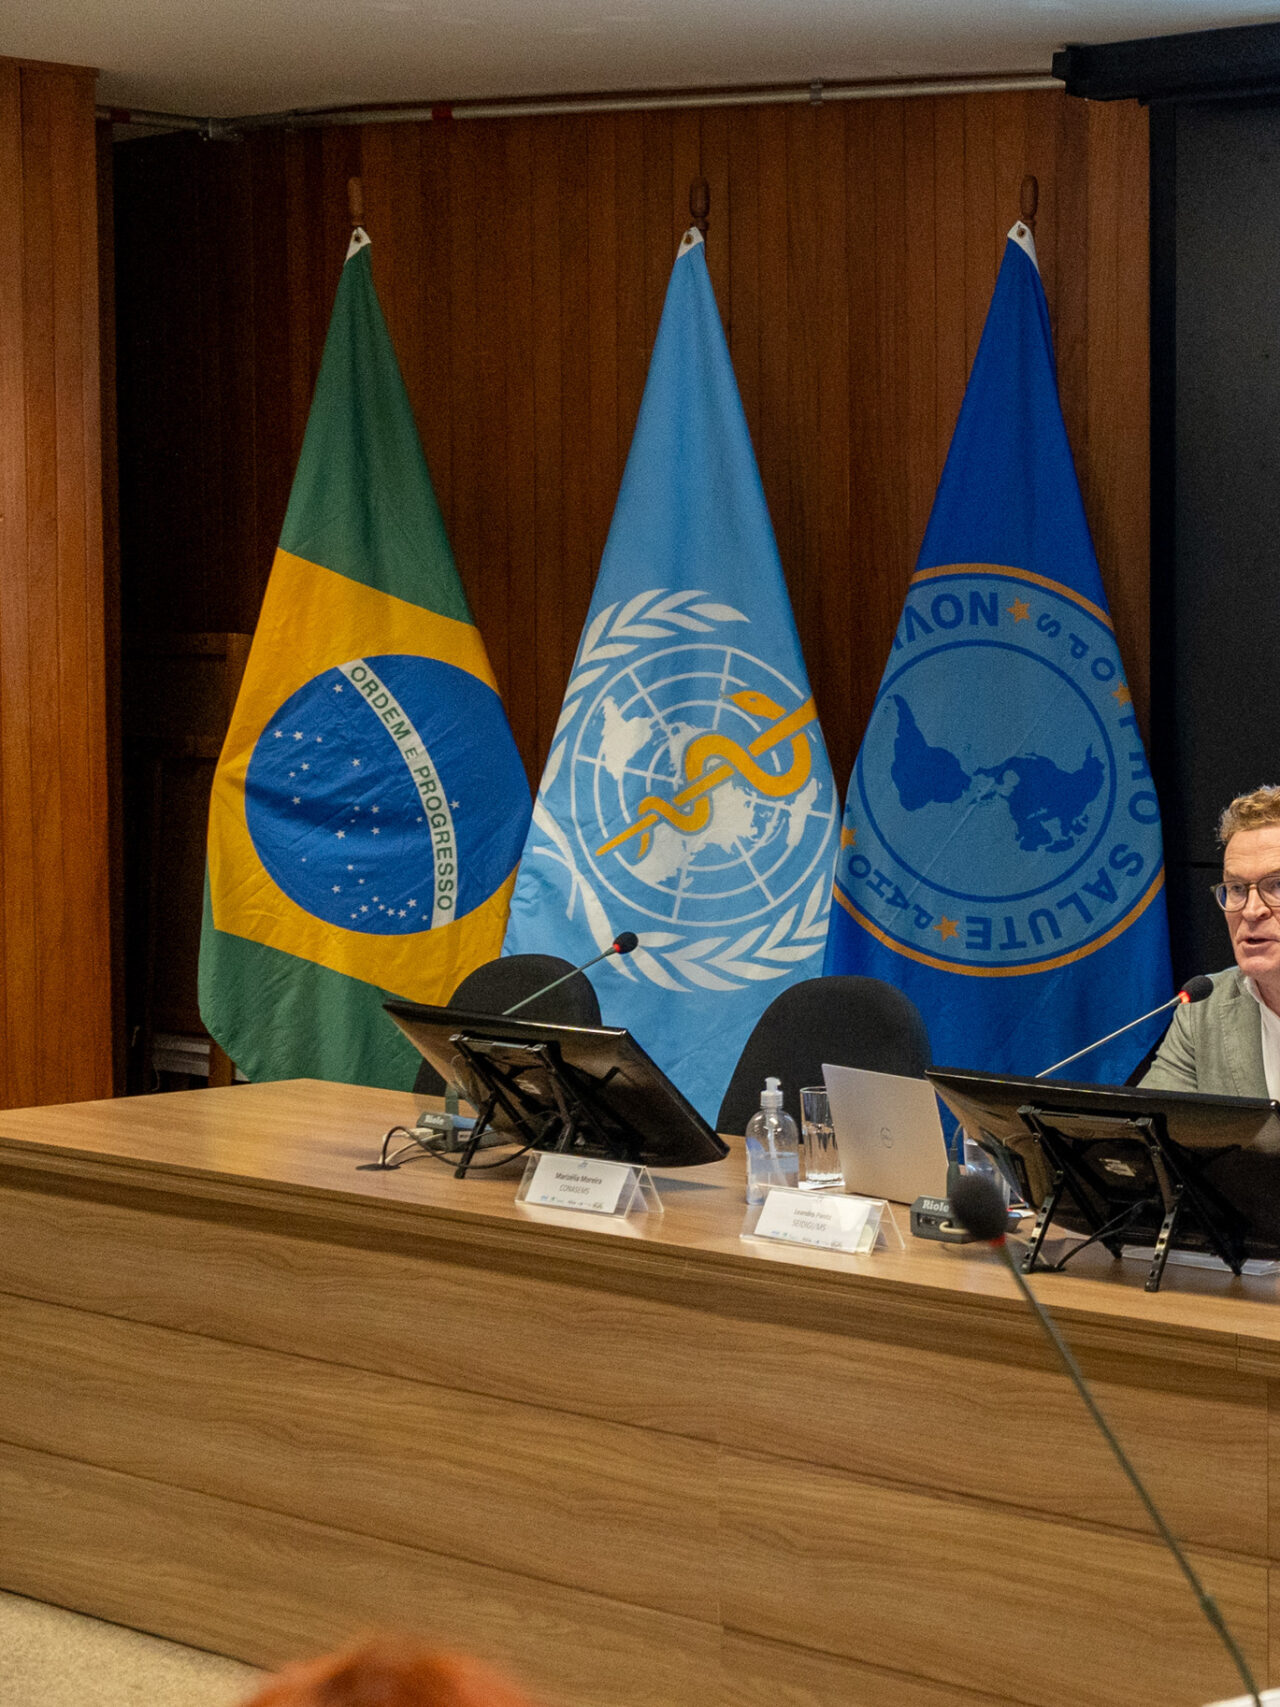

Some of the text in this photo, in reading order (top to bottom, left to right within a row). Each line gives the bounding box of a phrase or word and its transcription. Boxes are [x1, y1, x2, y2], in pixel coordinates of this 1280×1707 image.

[1036, 612, 1116, 682] OPS
[350, 666, 454, 911] ORDEM E PROGRESSO
[848, 854, 934, 929] PAHO
[965, 843, 1145, 950] SALUTE
